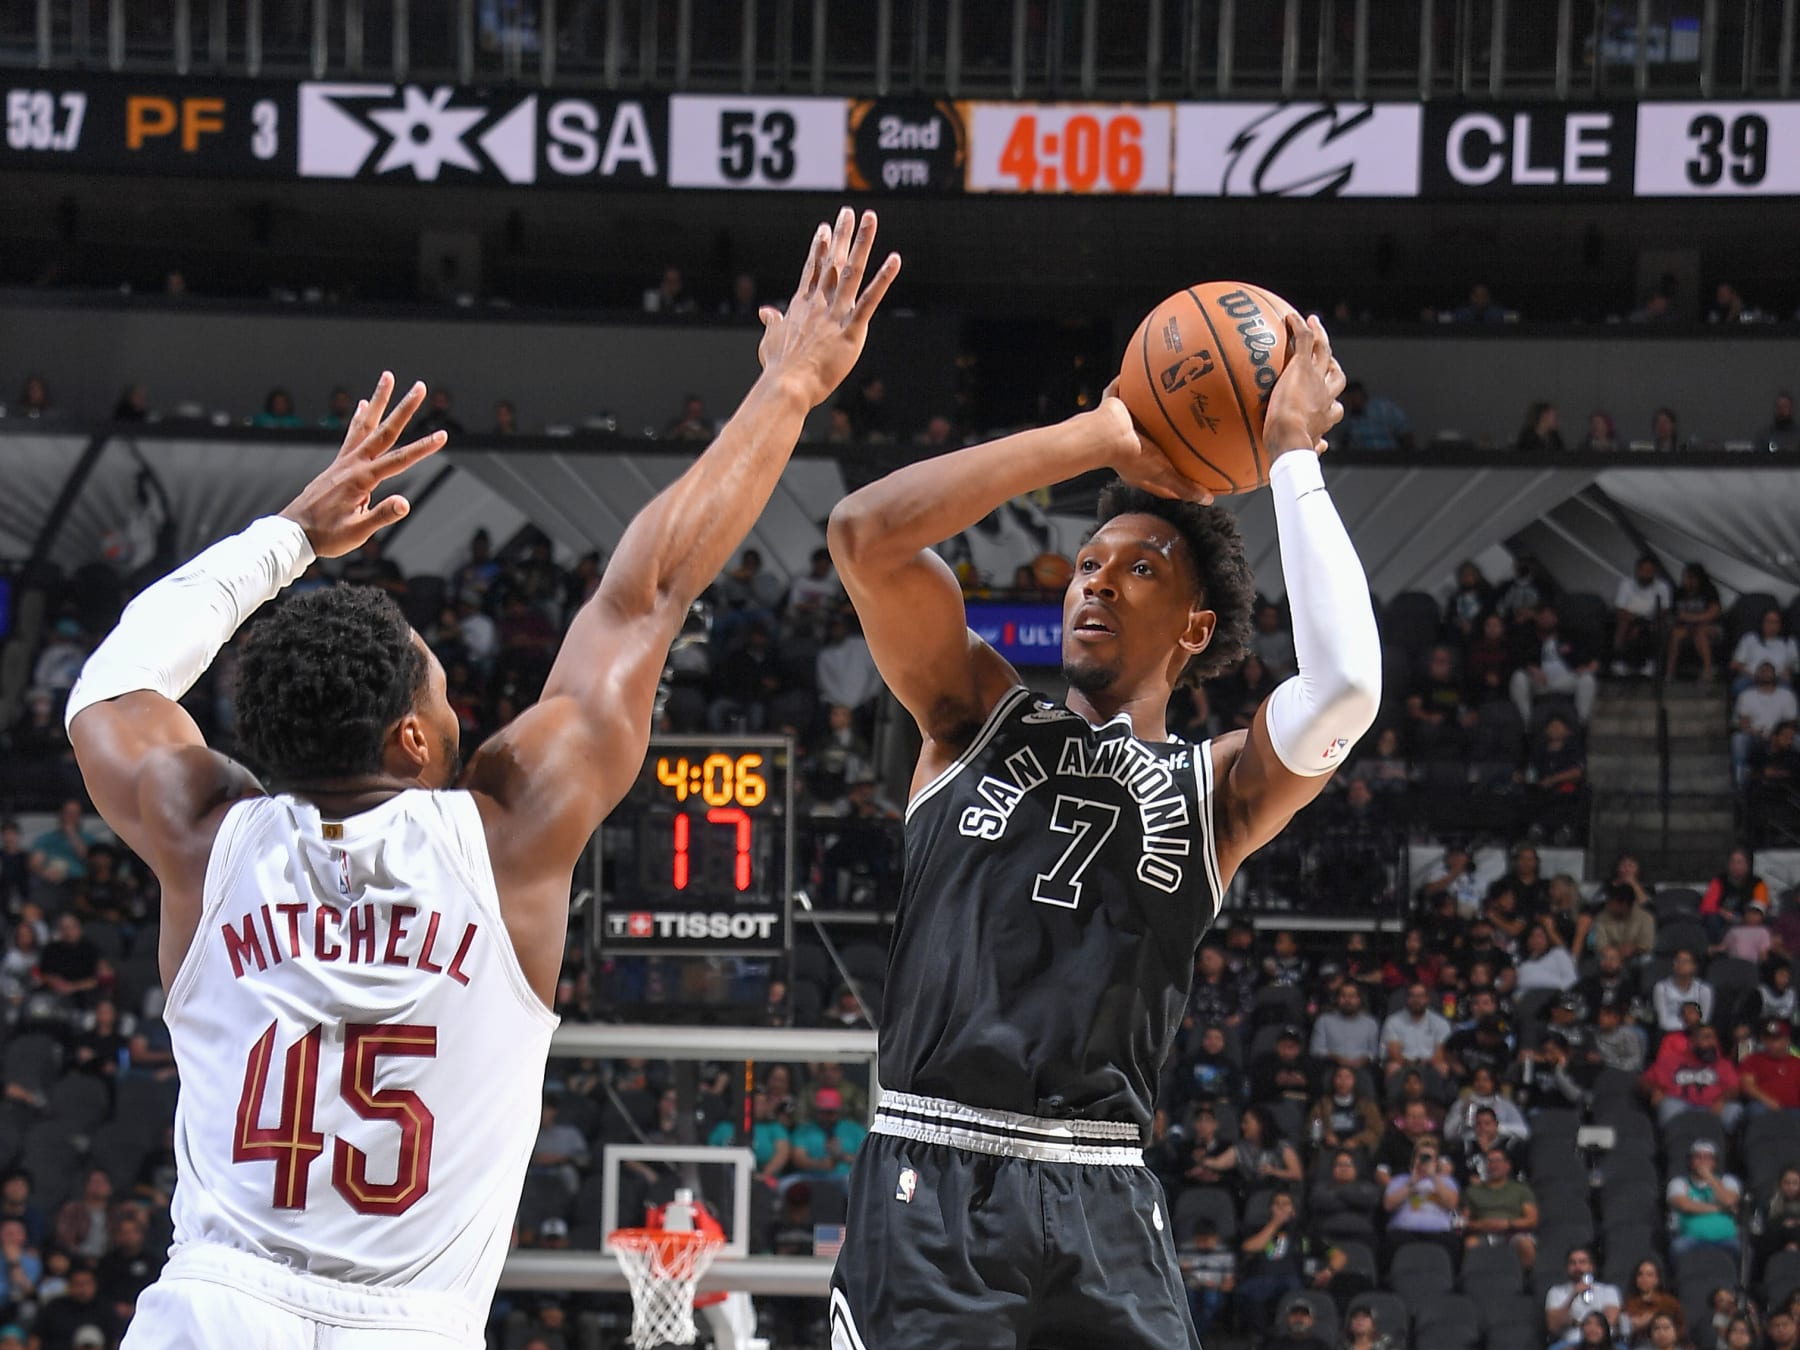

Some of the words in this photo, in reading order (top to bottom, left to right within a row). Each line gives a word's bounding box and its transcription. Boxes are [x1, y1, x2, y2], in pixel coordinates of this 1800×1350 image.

[6, 90, 87, 150] 53.7
[127, 96, 225, 150] PF
[252, 101, 278, 159] 3
[547, 99, 657, 176] SA
[719, 111, 796, 182] 53
[878, 117, 940, 150] 2nd
[998, 114, 1144, 190] 4:06
[1446, 113, 1613, 185] CLE
[1686, 113, 1768, 187] 39
[883, 161, 929, 188] QTR
[1216, 289, 1277, 405] Wilso
[656, 753, 767, 807] 4:06
[959, 746, 1048, 841] SAN
[1056, 736, 1190, 894] ANTONIO
[673, 808, 751, 891] 17
[1032, 794, 1120, 909] 7
[221, 903, 478, 987] MITCHELL
[655, 912, 778, 939] TISSOT
[232, 1018, 438, 1216] 45
